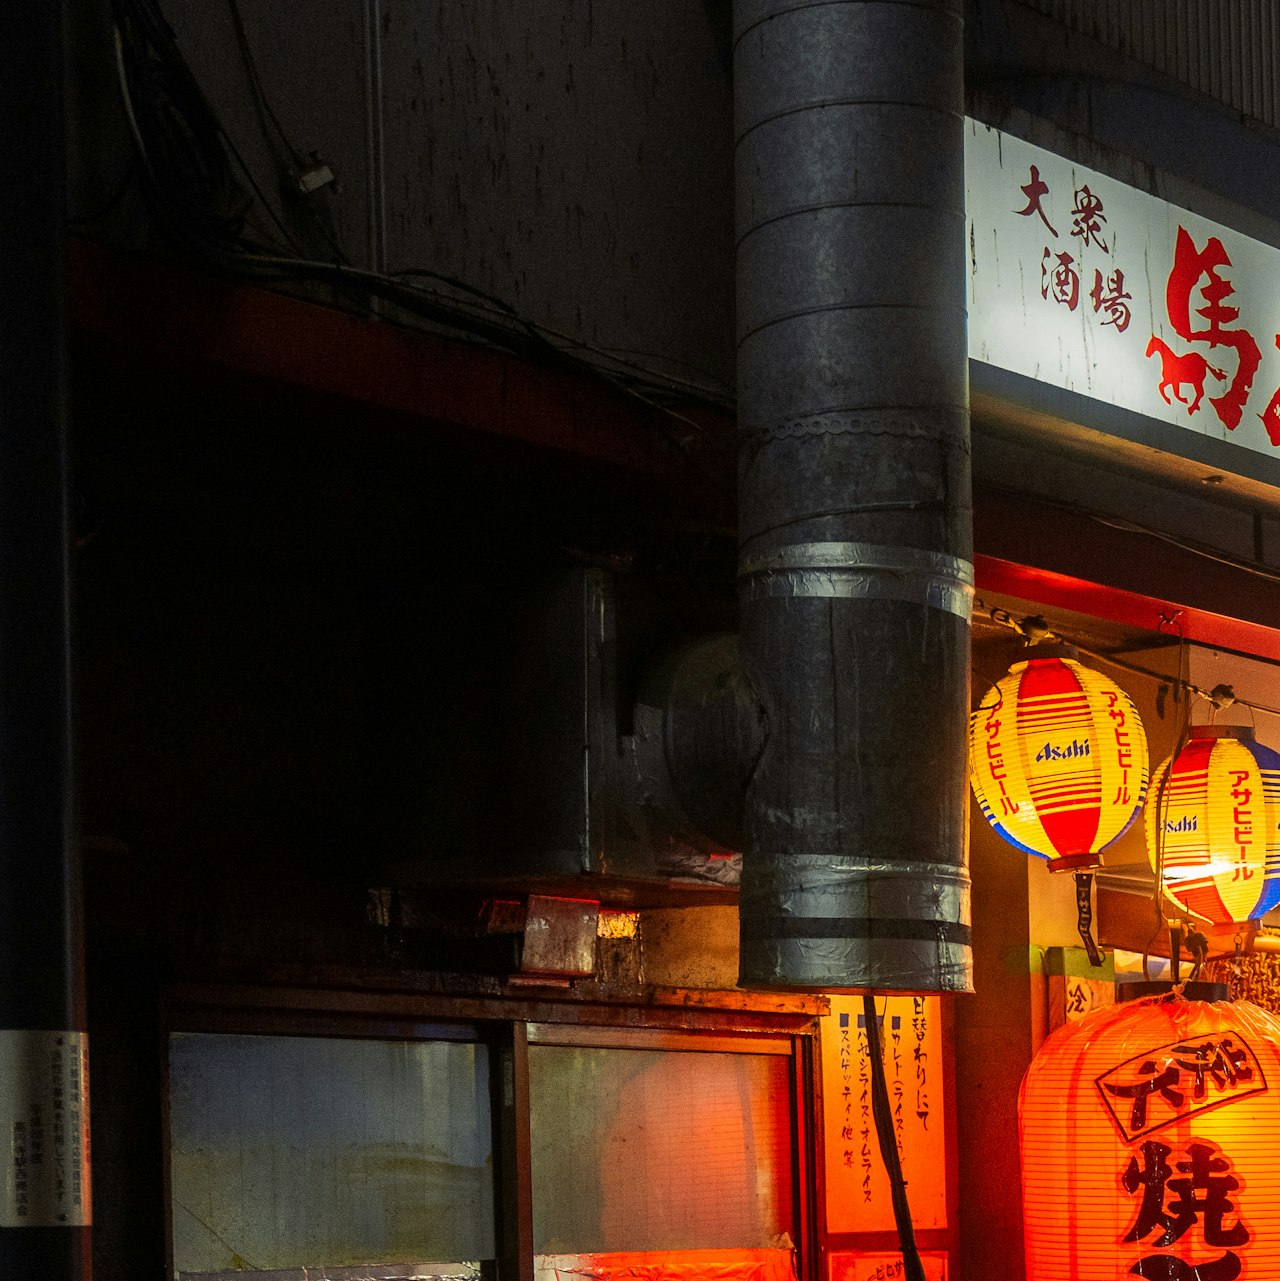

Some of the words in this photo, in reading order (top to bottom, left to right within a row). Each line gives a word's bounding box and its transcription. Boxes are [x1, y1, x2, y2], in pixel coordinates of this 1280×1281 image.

[1012, 165, 1109, 253] 大衆
[1040, 246, 1131, 332] 酒場
[984, 700, 1020, 816] アサヒビール
[1036, 738, 1091, 762] Asahi
[1100, 691, 1132, 805] アサヒビール
[1228, 770, 1254, 882] アサヒビール
